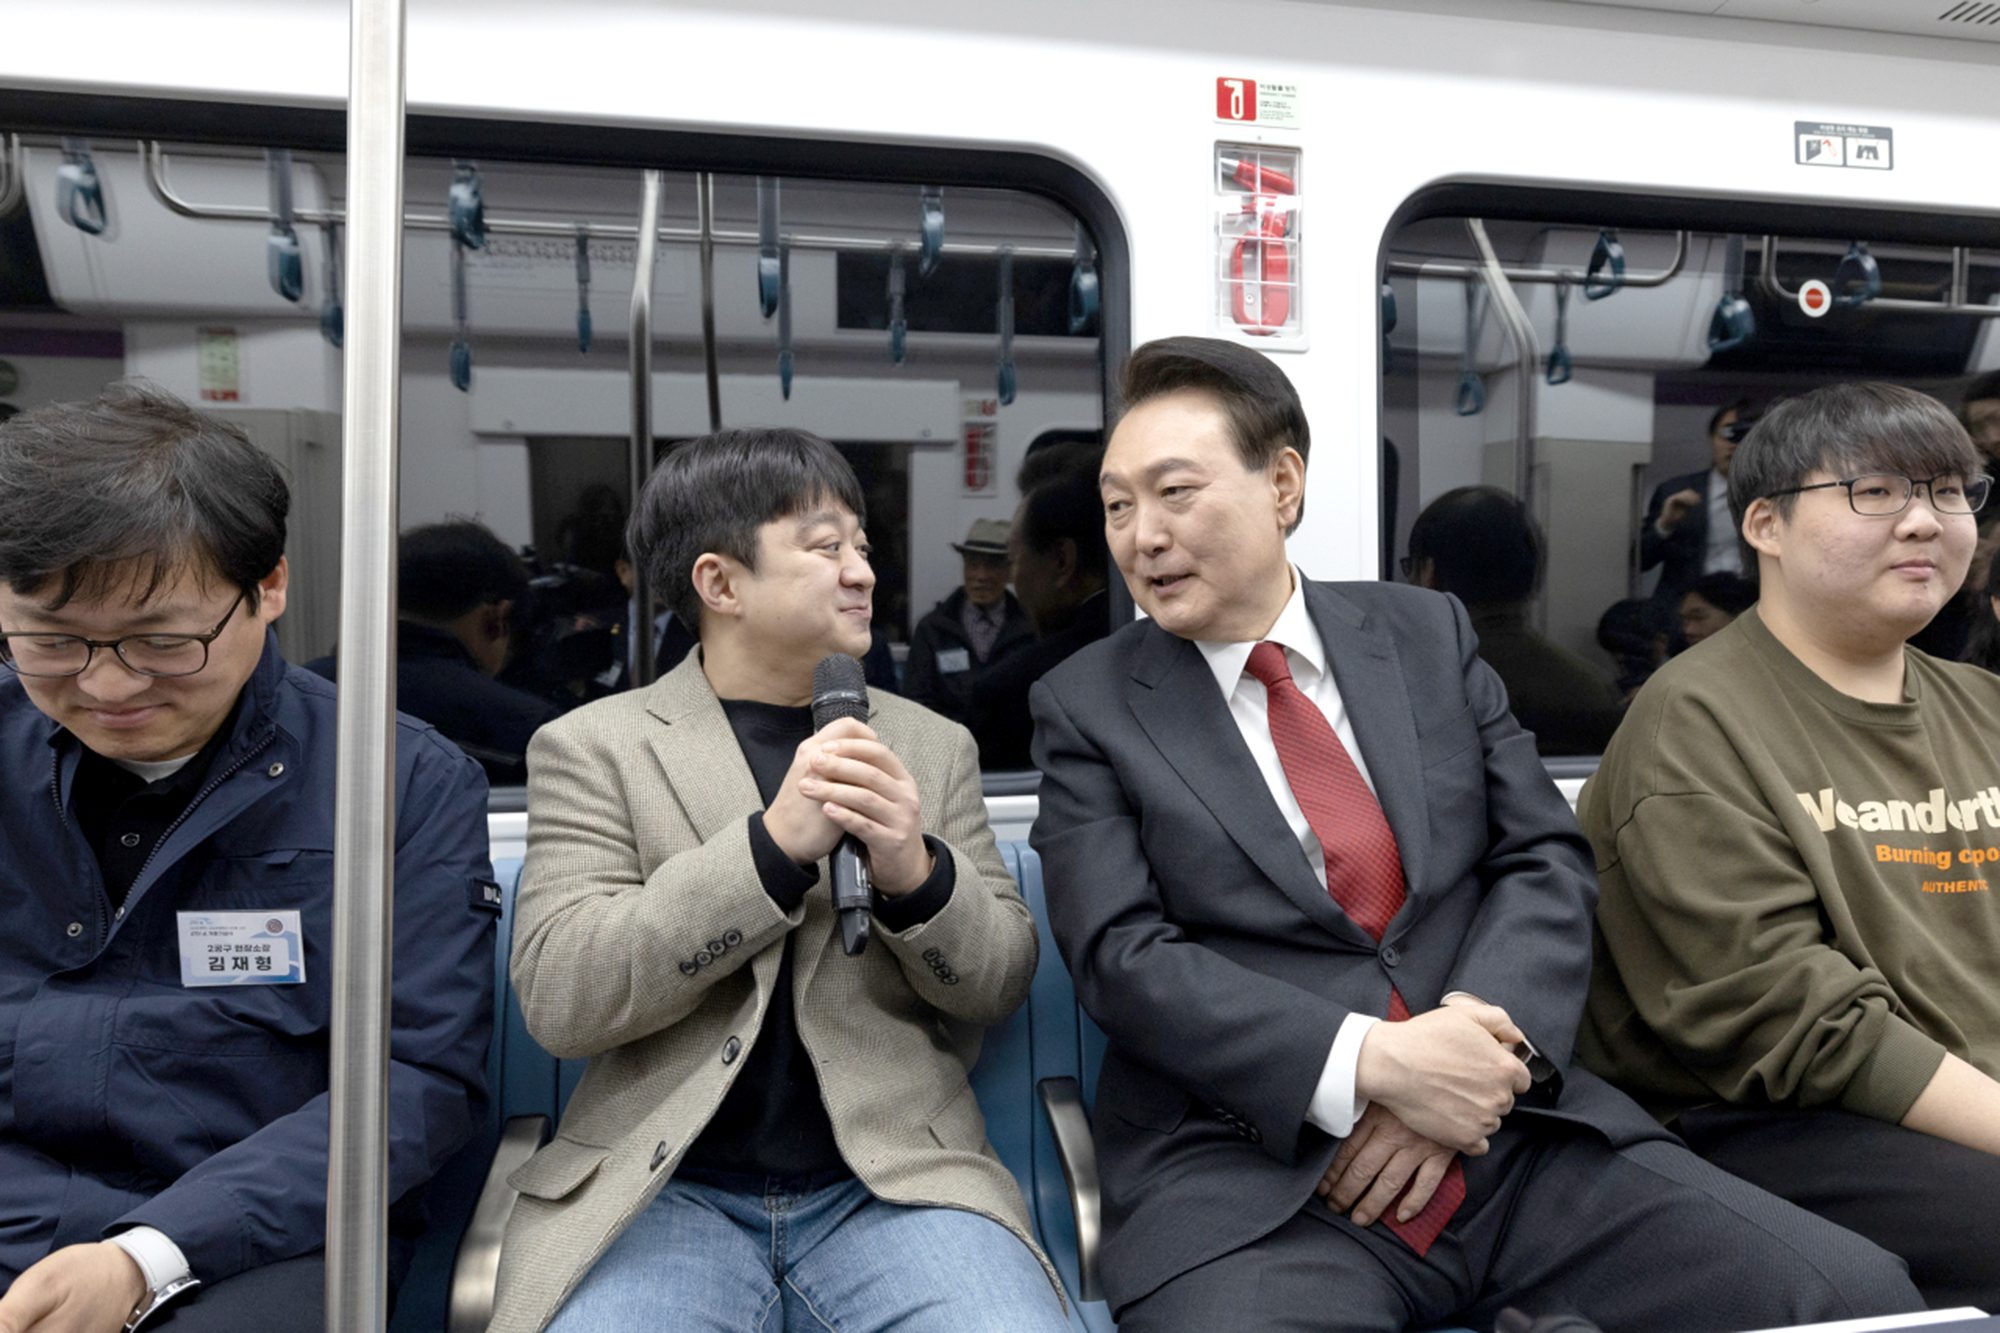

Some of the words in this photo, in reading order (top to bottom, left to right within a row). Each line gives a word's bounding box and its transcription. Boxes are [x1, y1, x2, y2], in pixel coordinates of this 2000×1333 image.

[1875, 844, 1952, 870] Burning
[1957, 846, 2000, 868] cpo
[207, 944, 233, 953] 2공구
[234, 944, 272, 953] 현장소장
